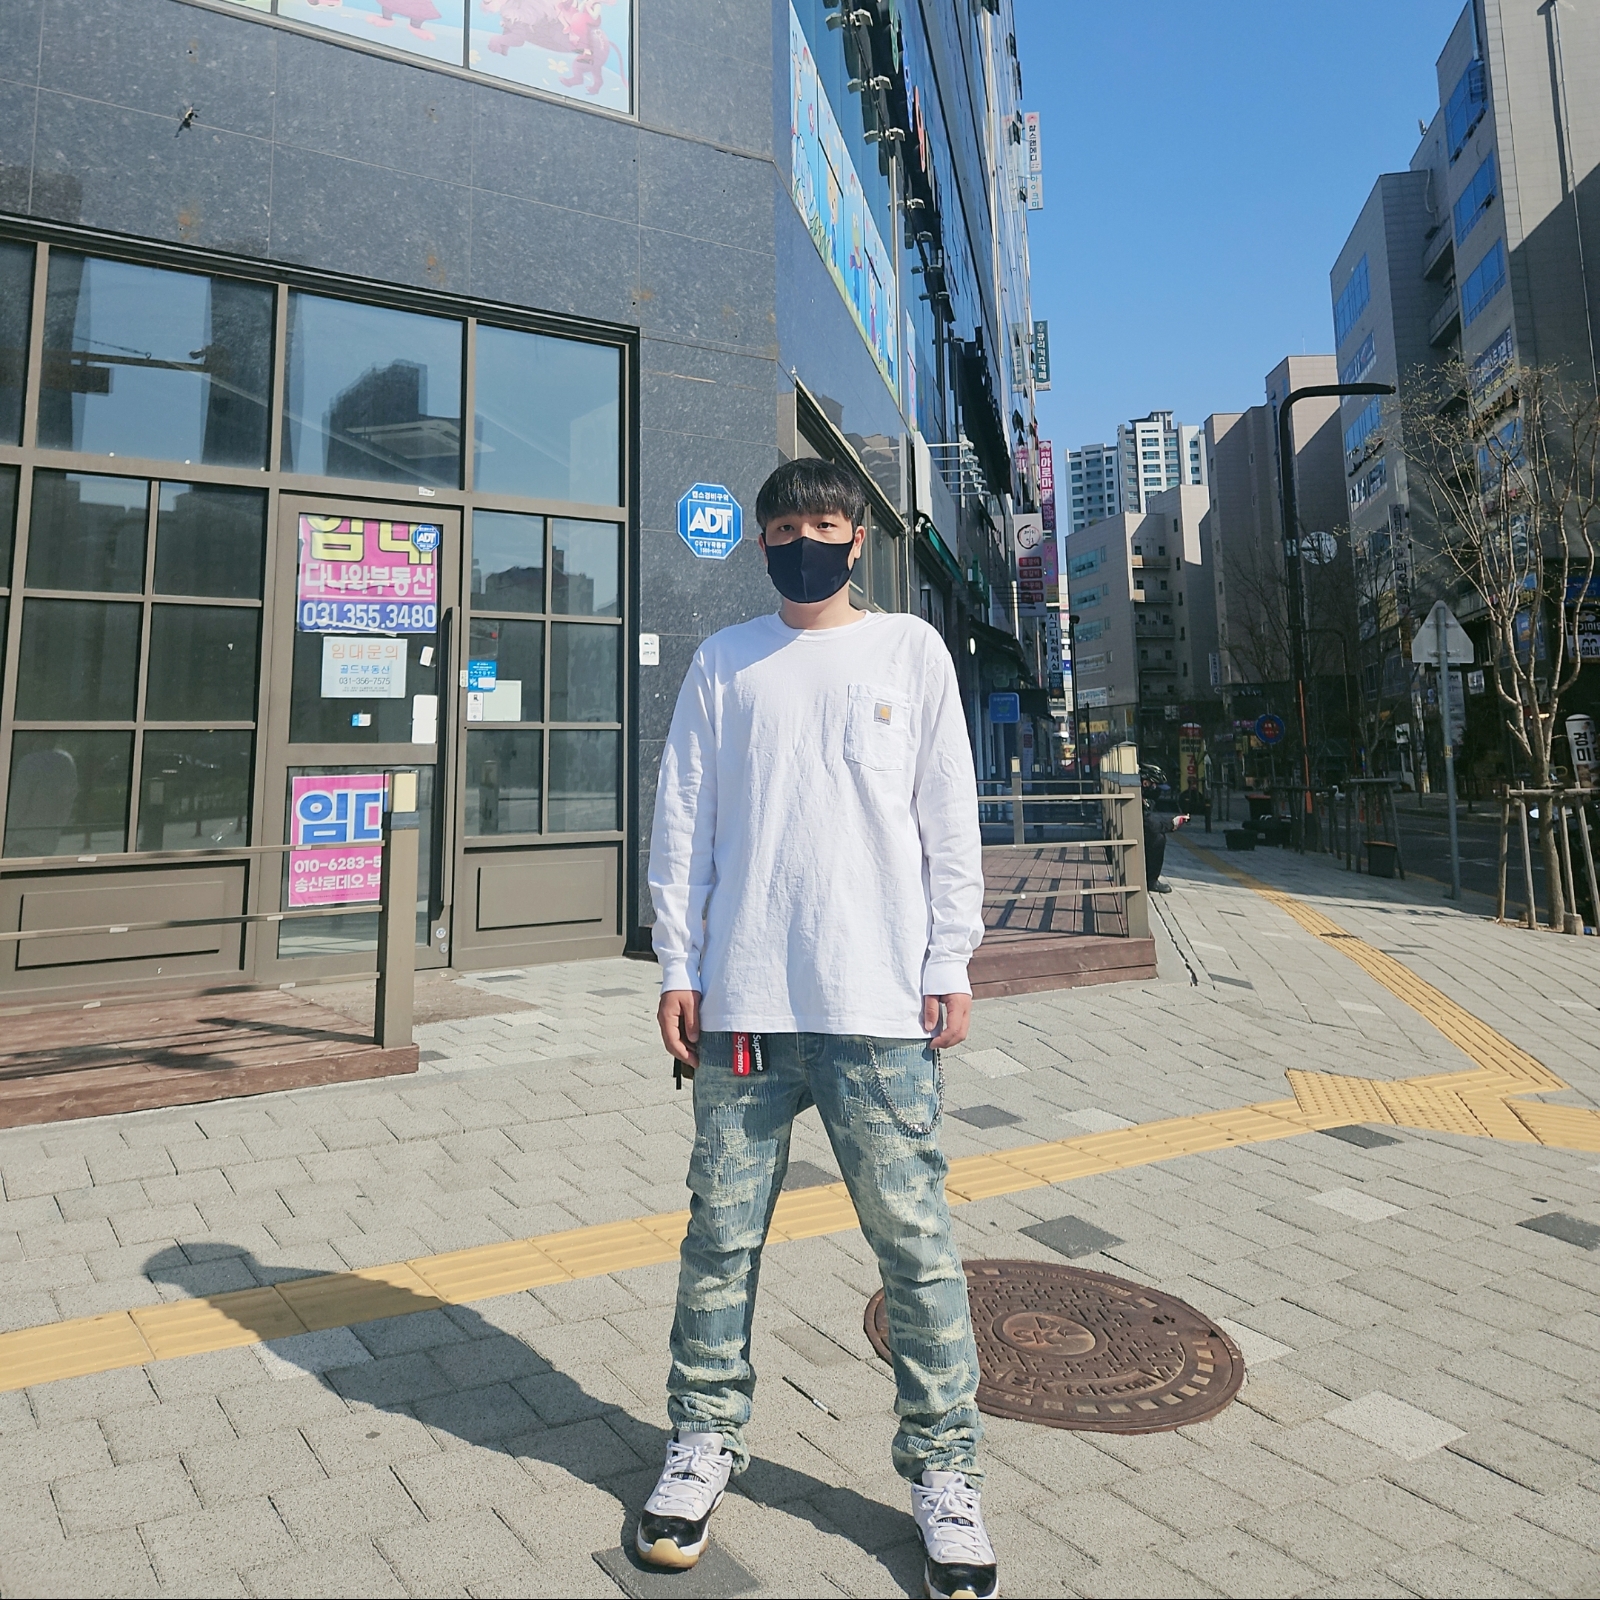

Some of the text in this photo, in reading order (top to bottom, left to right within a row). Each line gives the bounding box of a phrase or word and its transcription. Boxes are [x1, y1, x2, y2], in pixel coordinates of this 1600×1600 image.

[689, 507, 732, 534] ADT
[417, 532, 436, 544] ADT
[306, 564, 433, 596] 다나와부동산
[303, 602, 436, 629] 031.355.3480
[331, 643, 399, 660] 임대문의
[1049, 613, 1060, 671] 시그니처독서실
[340, 664, 390, 675] 골드부동산
[338, 677, 391, 686] 031-356-7575
[294, 856, 381, 873] 010-6283-5
[295, 874, 364, 892] 송산로데오
[735, 1035, 746, 1073] Supreme
[751, 1034, 763, 1071] Supreme
